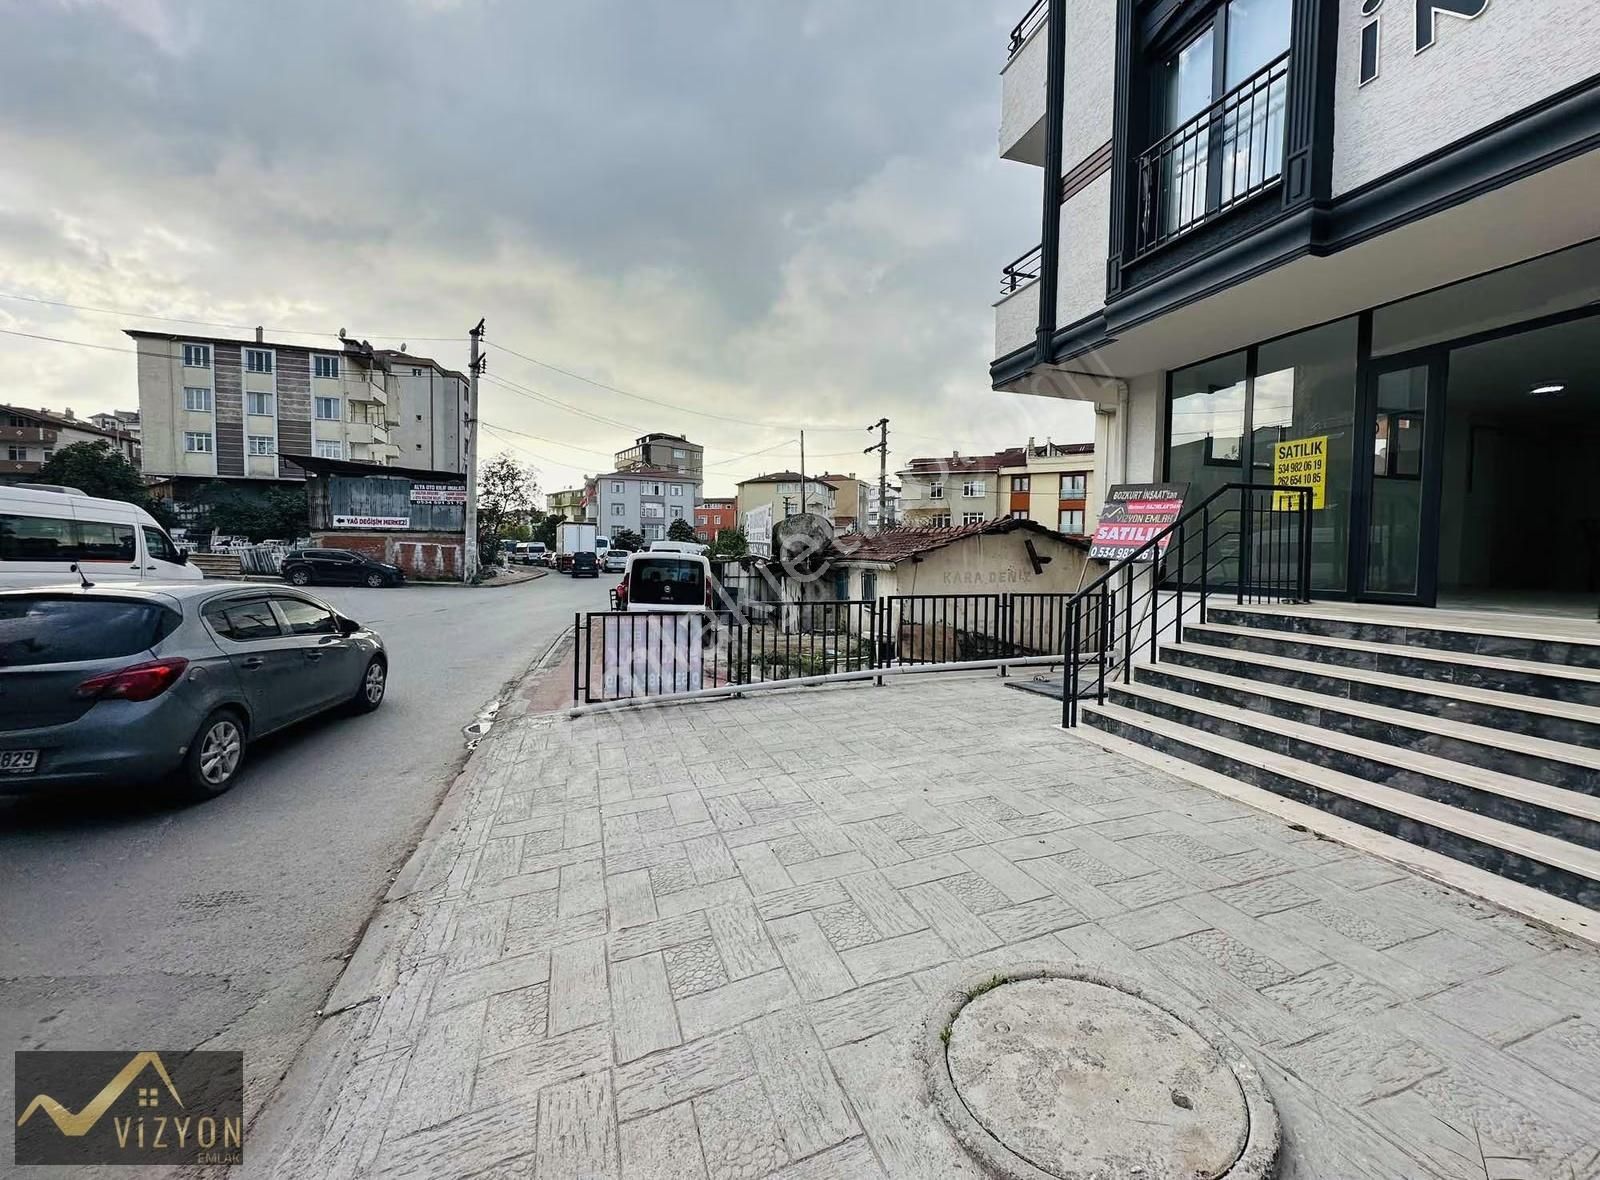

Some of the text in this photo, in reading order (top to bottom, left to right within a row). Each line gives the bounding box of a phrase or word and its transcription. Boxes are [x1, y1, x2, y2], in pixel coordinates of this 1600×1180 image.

[1279, 441, 1323, 459] SATILIK
[1279, 459, 1322, 474] 534 982 06 19
[1304, 473, 1312, 484] 10
[1312, 472, 1321, 483] 85
[1113, 491, 1143, 500] BOZKURT
[347, 517, 359, 525] YAĞ
[360, 517, 383, 526] DEĞİŞİM
[1090, 547, 1098, 558] 0
[1098, 547, 1116, 558] 534
[943, 570, 984, 585] KARA
